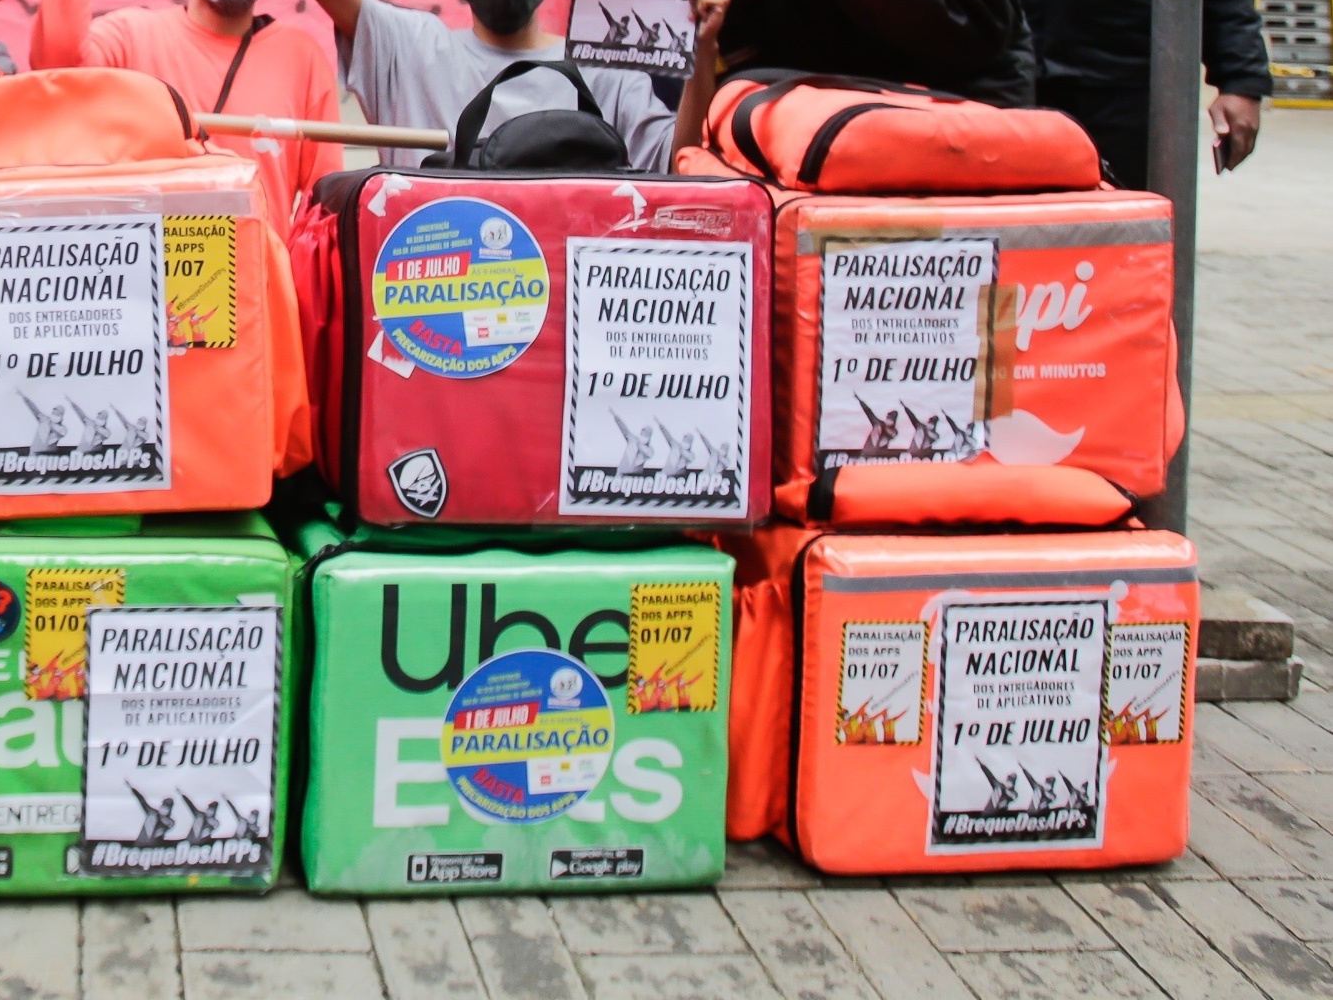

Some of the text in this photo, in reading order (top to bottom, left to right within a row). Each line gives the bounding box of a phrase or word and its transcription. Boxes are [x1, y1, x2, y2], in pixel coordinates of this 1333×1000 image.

[176, 243, 204, 253] APPS
[397, 257, 461, 280] 1 DE JULHO
[832, 250, 982, 282] PARALISAÇÃO
[0, 274, 127, 304] NACIONAL
[585, 262, 730, 298] PARALISAÇÃO
[384, 275, 544, 306] PARALISAÇÃO
[844, 285, 966, 311] NACIONAL
[9, 308, 123, 323] DOS ENTREGADORES
[597, 298, 717, 326] NACIONAL
[14, 323, 120, 338] DE APLICATIVOS
[851, 317, 959, 330] DOS ENTREGADORES
[408, 319, 463, 356] BASTA
[606, 331, 712, 346] DOS ENTREGADORES
[854, 332, 955, 344] DE APLICATIVOS
[392, 327, 518, 372] PRECARIZAÇÃO DOS APPS
[609, 346, 709, 361] DE APLICATIVOS
[27, 353, 57, 378] DE
[65, 349, 144, 377] JULHO
[833, 358, 857, 383] 1º
[865, 357, 897, 382] DE
[900, 357, 977, 382] JULHO
[1013, 364, 1034, 378] EM
[1040, 363, 1106, 378] MINUTOS
[588, 372, 731, 400] 1º DE JULHO
[578, 468, 730, 497] #BrequeDosAPPs
[35, 597, 92, 608] DOS APPS
[641, 592, 714, 605] PARALISAÇÃO
[641, 609, 694, 621] DOS APPS
[640, 627, 693, 645] 01/07
[849, 630, 922, 643] PARALISAÇÃO
[955, 612, 1095, 647] PARALISAÇÃO
[1113, 630, 1182, 643] PARALISAÇÃO
[100, 620, 263, 660] PARALISAÇÃO
[848, 646, 900, 657] DOS APPS
[1113, 647, 1163, 657] DOS APPS
[848, 663, 899, 679] 01/07
[965, 649, 1080, 677] NACIONAL
[1112, 663, 1161, 680] 01/07
[114, 661, 247, 691] NACIONAL
[973, 682, 994, 693] DOS
[121, 696, 242, 710] DOS ENTREGADORES
[977, 694, 1072, 709] DE APLICATIVOS
[125, 711, 236, 727] DE APLICATIVOS
[465, 712, 470, 730] 1
[475, 709, 489, 728] DE
[492, 706, 529, 727] JULHO
[452, 724, 609, 754] PARALISAÇÃO
[953, 718, 1091, 746] 1º DE JULHO
[100, 738, 260, 767] 1º DE JULHO
[473, 769, 524, 803] BASTA
[943, 808, 1088, 835] #BrequeDosAPPs
[91, 839, 261, 867] #BrequeDosAPPs
[429, 864, 498, 882] App Store
[570, 860, 641, 878] Google play
